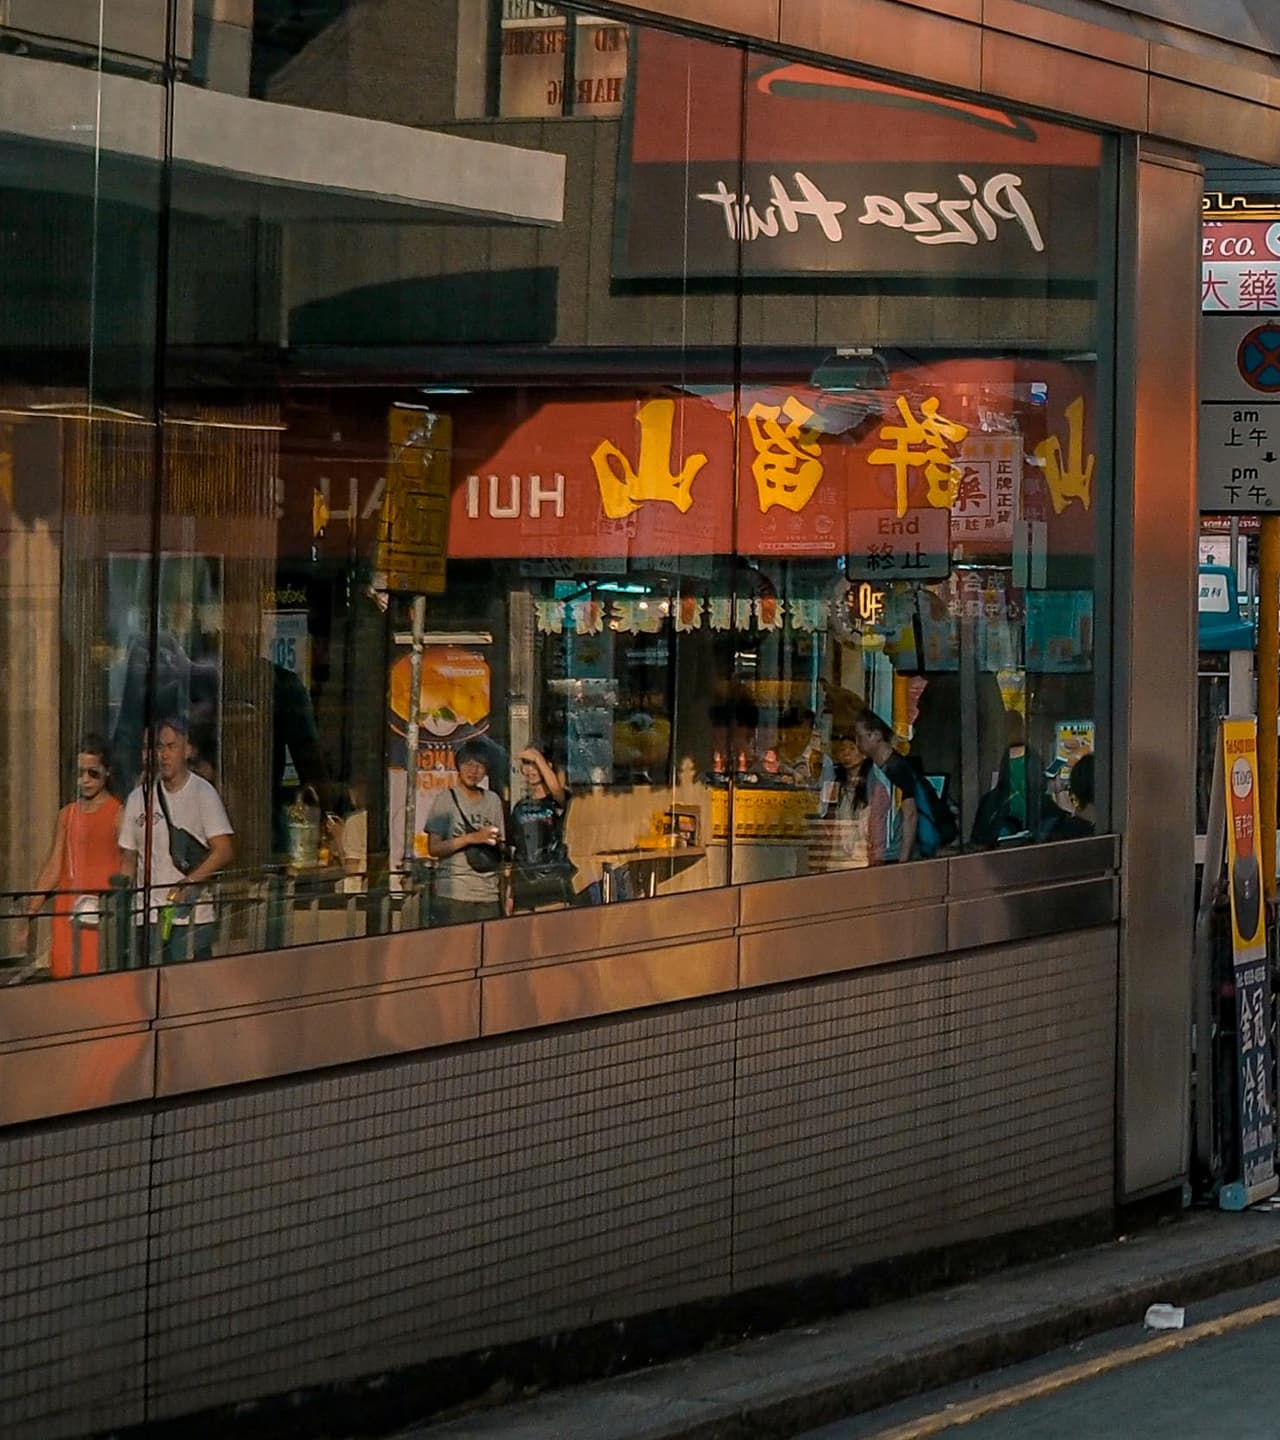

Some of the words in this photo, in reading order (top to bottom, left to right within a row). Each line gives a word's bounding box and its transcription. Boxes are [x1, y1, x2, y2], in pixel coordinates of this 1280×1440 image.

[1219, 237, 1256, 256] CO.
[1232, 410, 1259, 422] am
[1224, 427, 1268, 447] 上午
[1232, 467, 1258, 481] pm
[1224, 486, 1267, 504] 下午
